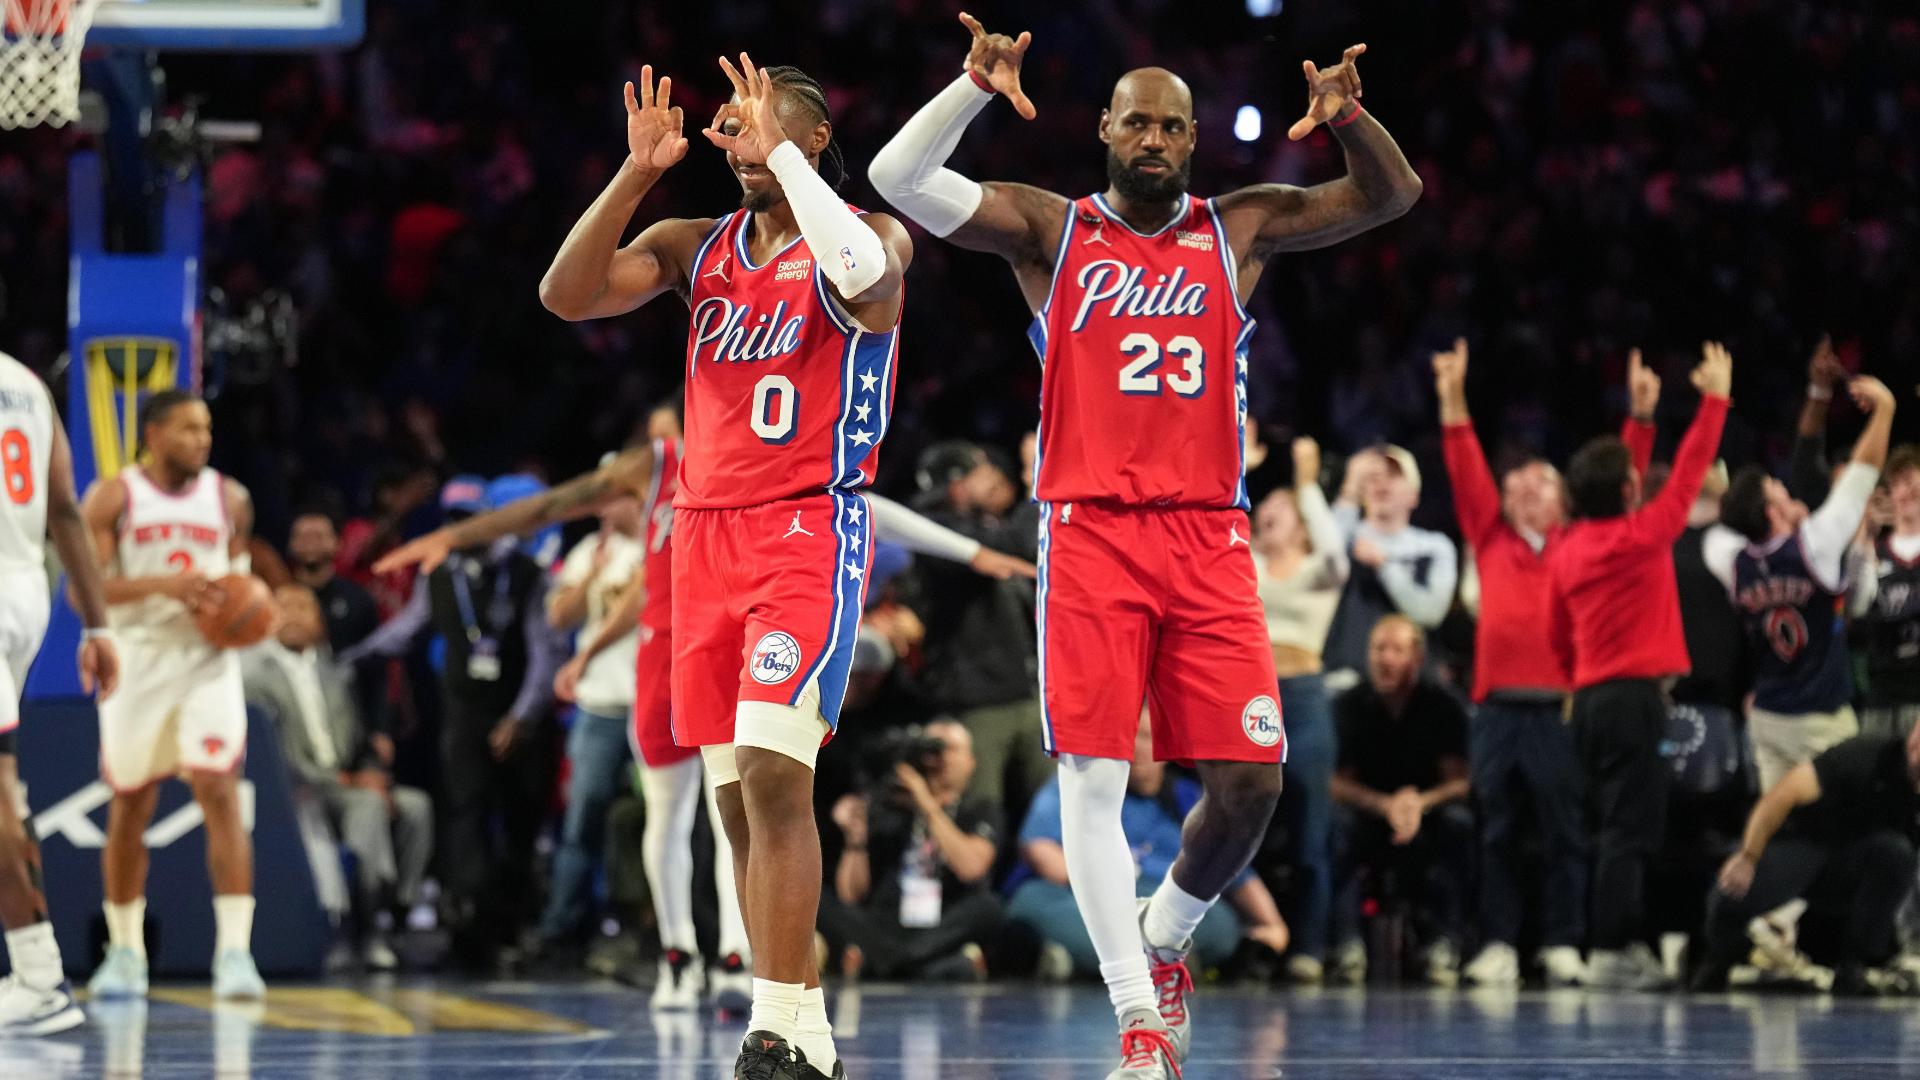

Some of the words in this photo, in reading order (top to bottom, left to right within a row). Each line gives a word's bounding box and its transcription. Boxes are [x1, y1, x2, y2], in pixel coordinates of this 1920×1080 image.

[1176, 230, 1213, 243] Bloom
[1177, 237, 1213, 251] energy
[775, 269, 809, 280] energy
[777, 260, 811, 272] Bloom
[1070, 259, 1208, 332] Phila
[692, 296, 805, 378] Phila
[1119, 333, 1206, 399] 23
[750, 374, 800, 446] 0
[1, 427, 34, 505] 8
[1764, 606, 1809, 663] 0
[753, 650, 792, 673] 76ers
[1248, 714, 1280, 734] 76er
